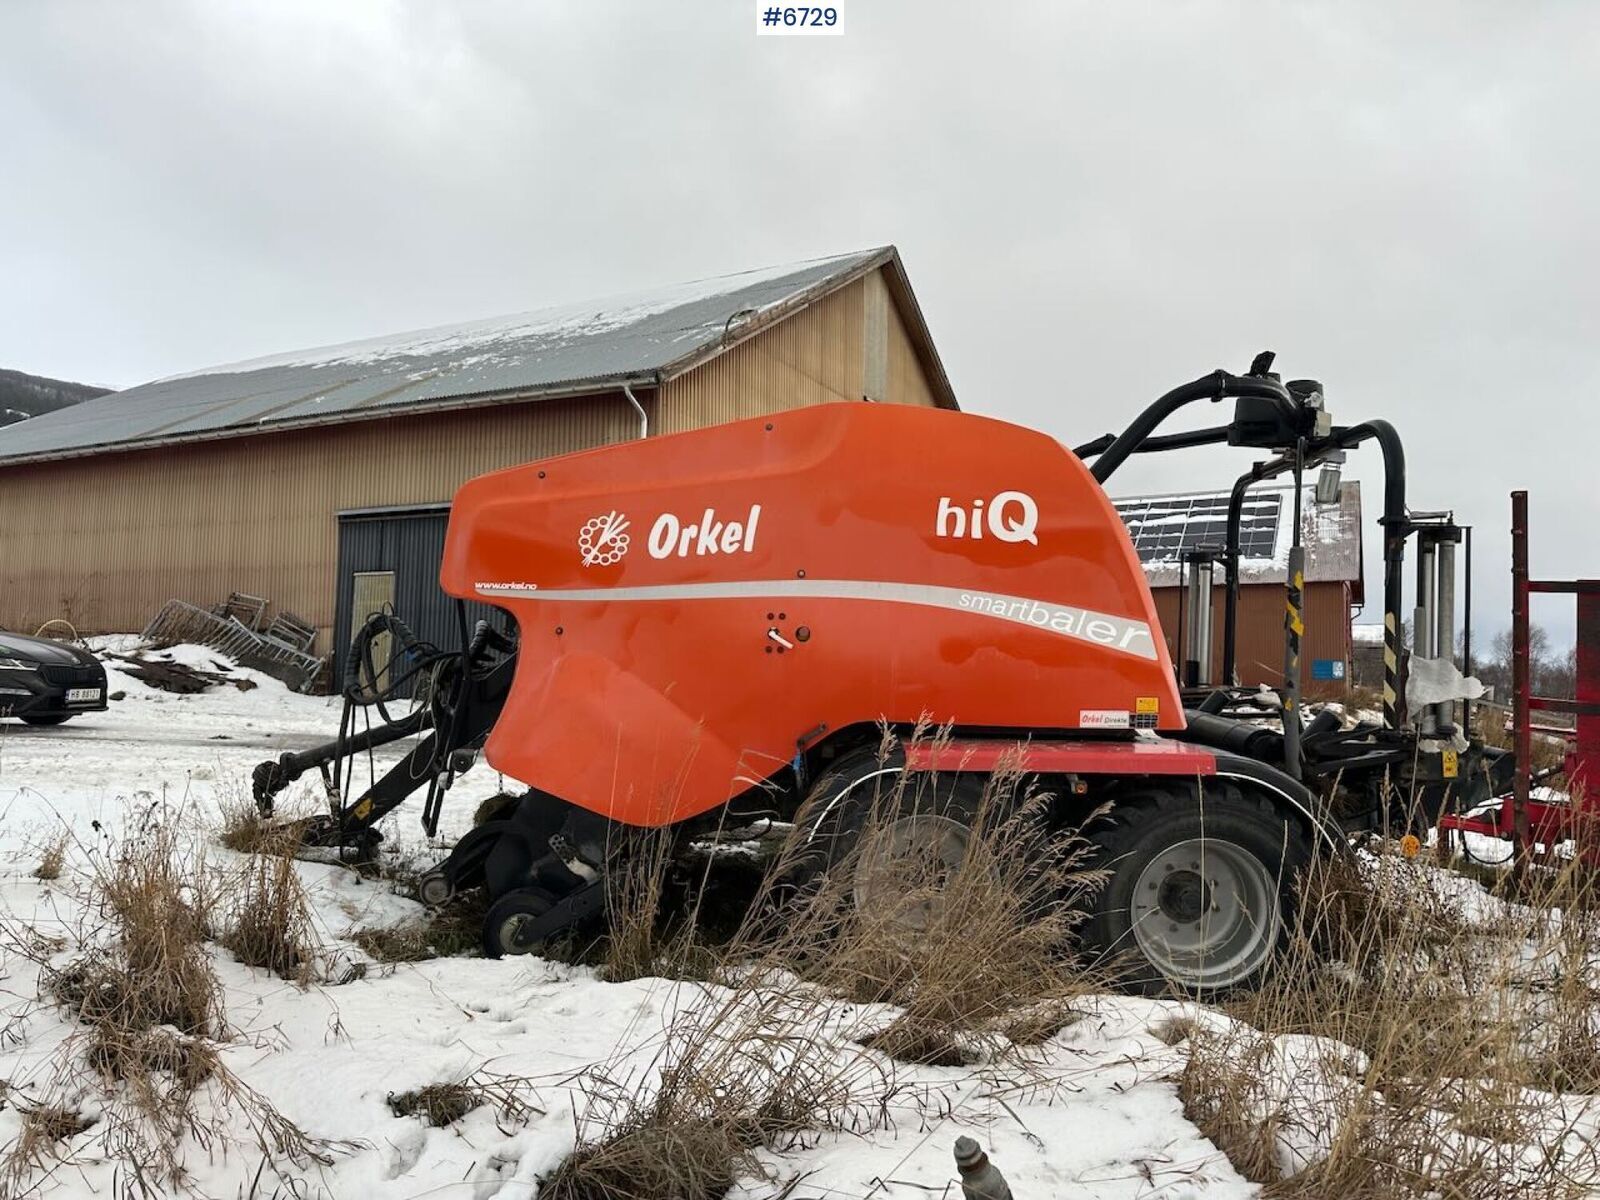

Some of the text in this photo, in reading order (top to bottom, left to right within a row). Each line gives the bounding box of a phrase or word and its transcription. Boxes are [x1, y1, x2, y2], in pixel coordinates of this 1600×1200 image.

[648, 504, 761, 559] Orkel
[936, 490, 1039, 546] hiQ
[474, 581, 538, 590] www.orkel.no
[959, 593, 1151, 648] smartbaler
[1082, 713, 1103, 723] Orkel
